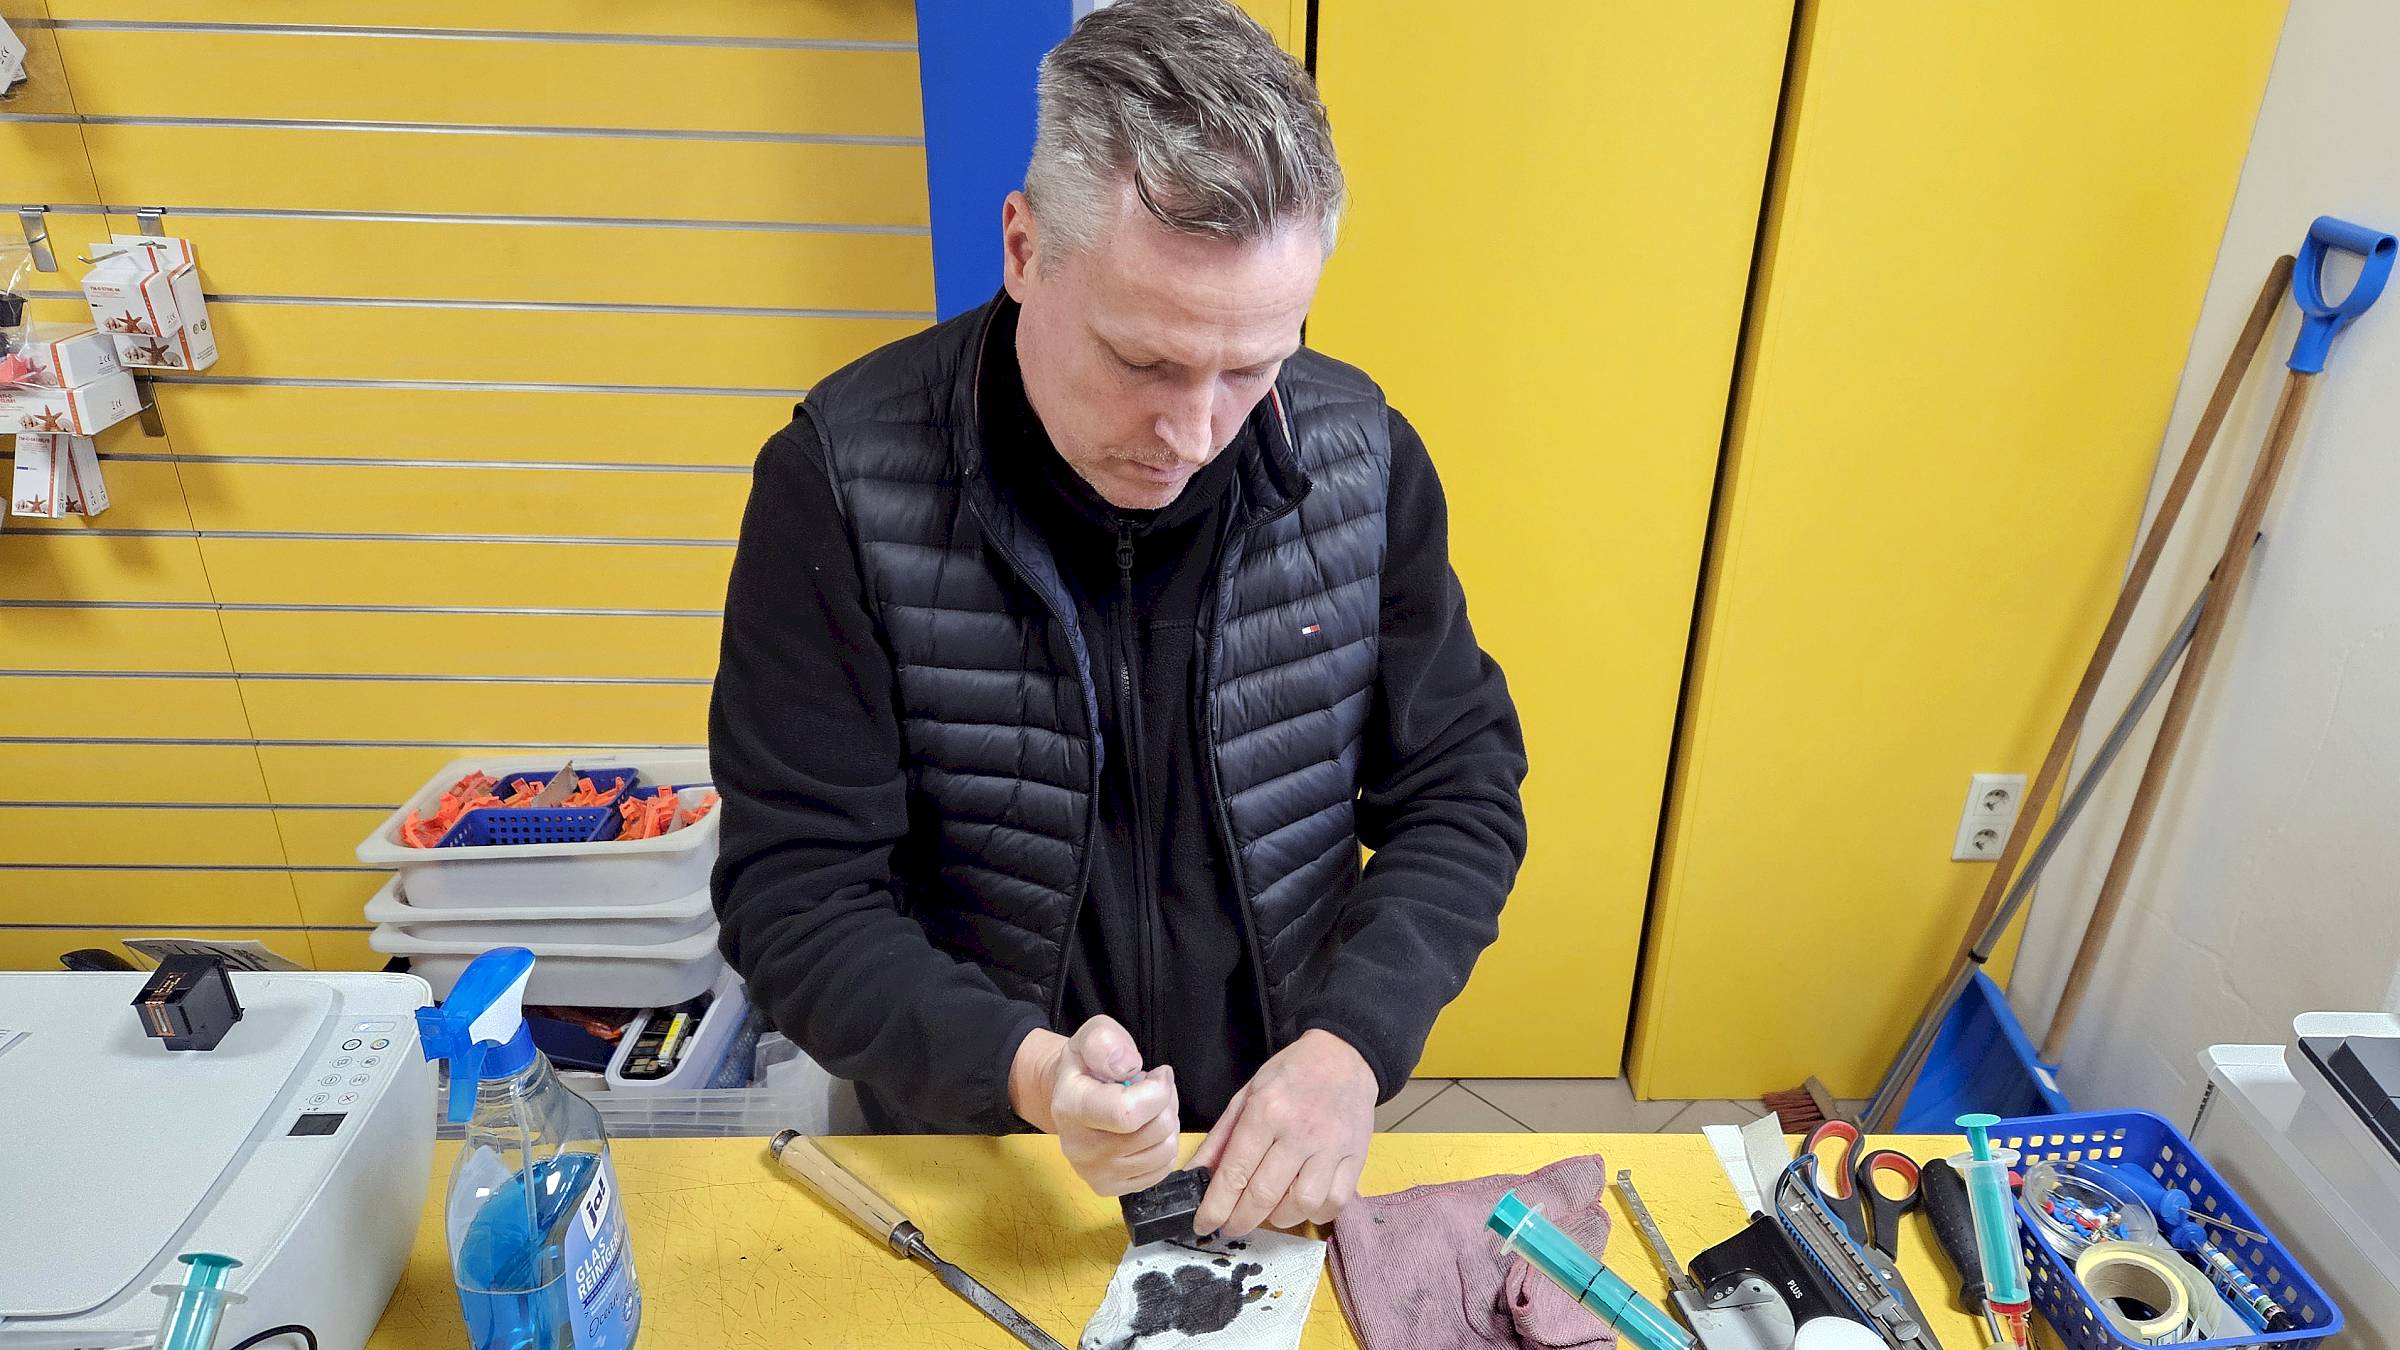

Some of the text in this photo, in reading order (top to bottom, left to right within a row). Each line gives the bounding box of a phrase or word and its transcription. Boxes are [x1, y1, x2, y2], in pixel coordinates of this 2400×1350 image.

[586, 1176, 606, 1229] ja!
[575, 1236, 606, 1284] GLAS
[577, 1231, 619, 1300] REINIGER
[1786, 1279, 1803, 1299] PLUS
[589, 1292, 619, 1338] Ocean
